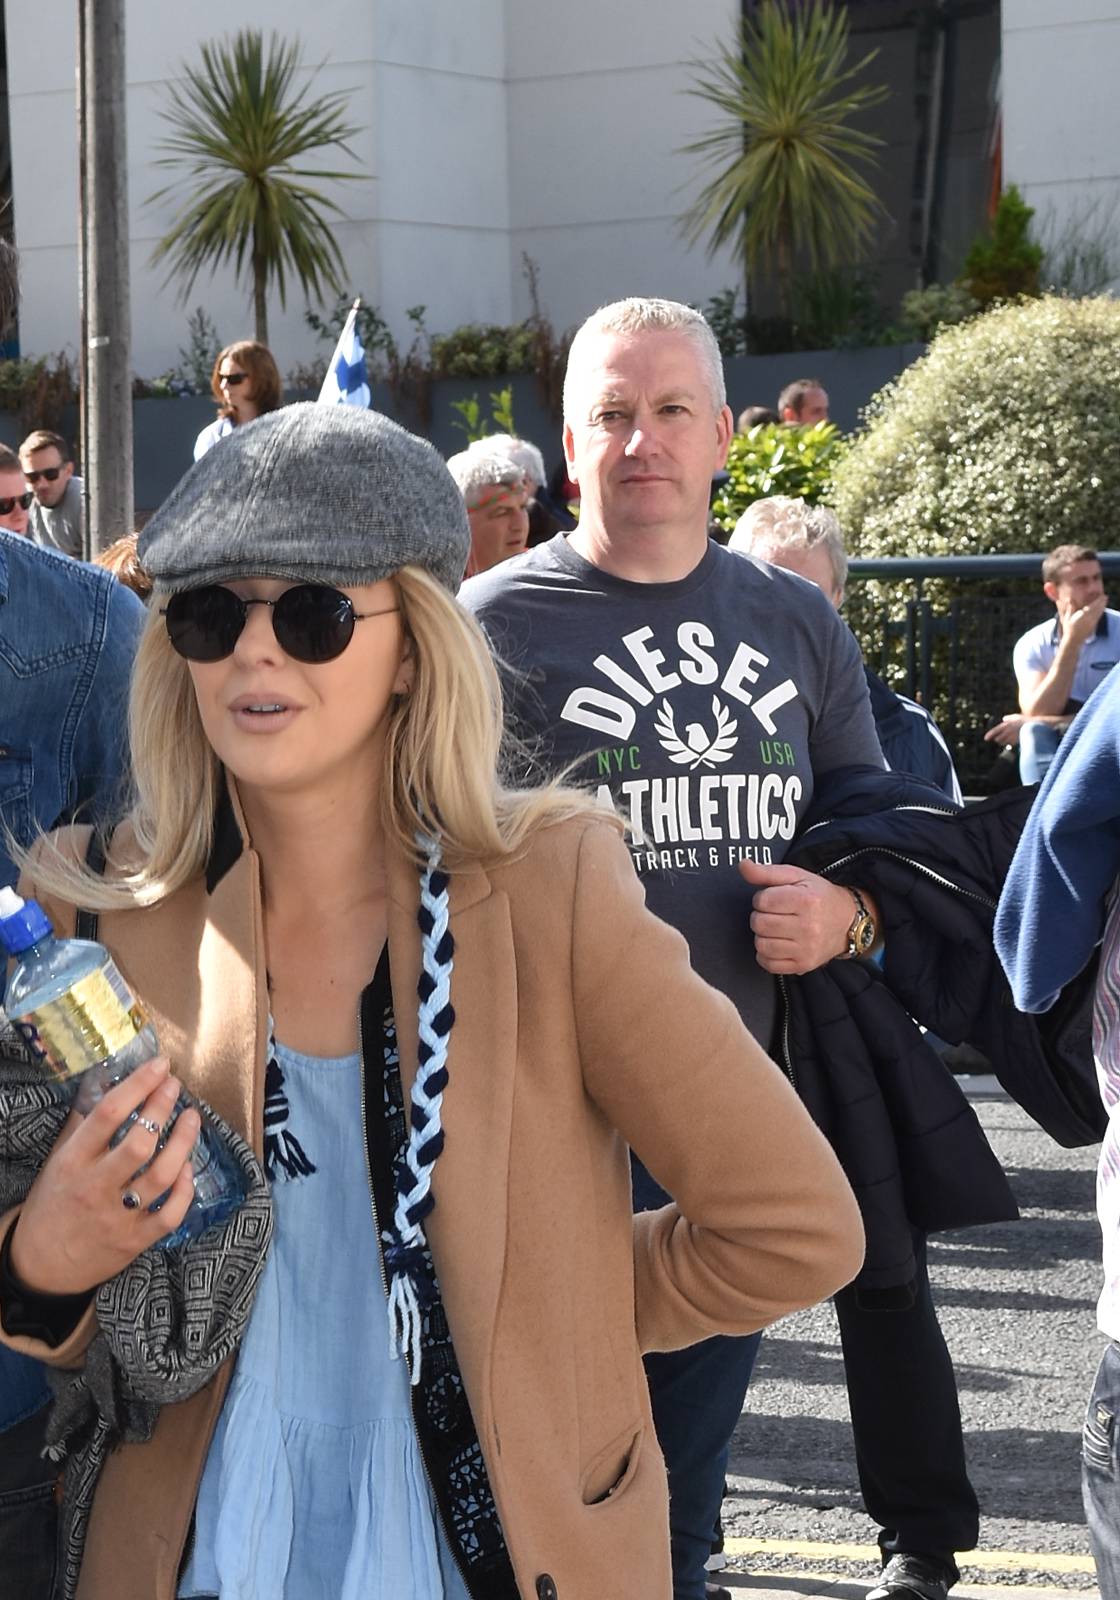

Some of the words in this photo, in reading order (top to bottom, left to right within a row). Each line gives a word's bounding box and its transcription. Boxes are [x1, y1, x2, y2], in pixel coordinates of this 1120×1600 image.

[560, 621, 799, 741] DIESEL
[597, 746, 641, 775] NYC
[759, 741, 795, 767] USA
[633, 848, 700, 872] TRACK
[709, 848, 719, 867] &
[728, 846, 772, 866] FIELD
